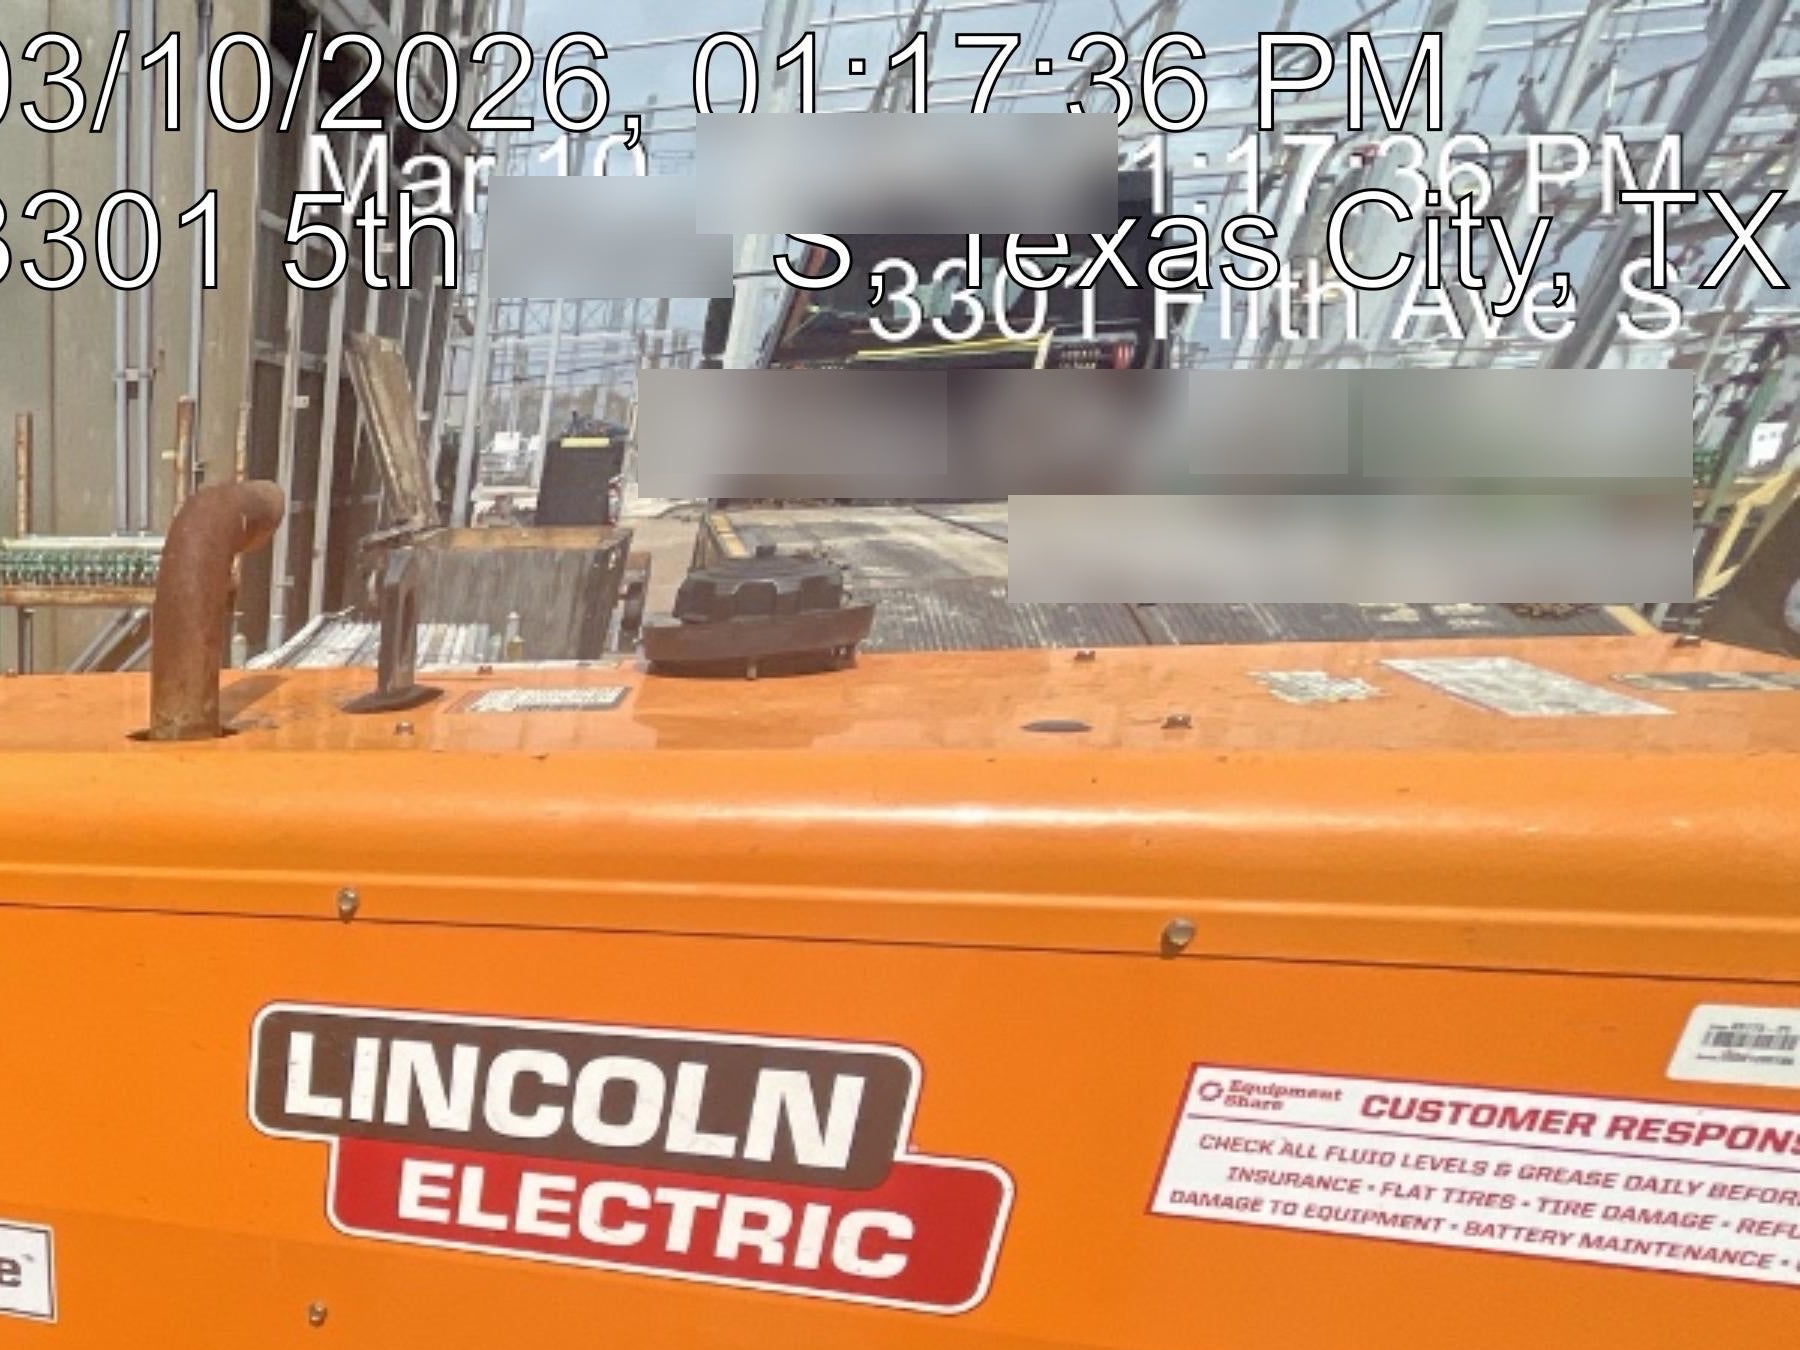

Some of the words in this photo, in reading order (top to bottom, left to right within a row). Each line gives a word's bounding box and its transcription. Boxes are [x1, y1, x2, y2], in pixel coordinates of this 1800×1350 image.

[284, 1031, 867, 1169] LINCOLN
[1223, 1094, 1284, 1111] Share
[1228, 1079, 1343, 1102] Equipment
[1360, 1093, 1597, 1139] CUSTOMER
[1199, 1133, 1273, 1156] CHECK
[1278, 1138, 1318, 1159] ALL
[1324, 1145, 1397, 1169] FLUID
[1401, 1152, 1490, 1177] LEVELS
[1493, 1161, 1512, 1177] &
[1517, 1163, 1620, 1190] GREASE
[1623, 1174, 1705, 1197] DAILY
[1707, 1180, 1800, 1207] BEFOR
[1227, 1166, 1363, 1194] INSURANCE
[1379, 1181, 1436, 1202] FLAT
[1443, 1187, 1516, 1210] TIRES
[1537, 1197, 1599, 1220] TIRE
[1601, 1204, 1718, 1231] DAMAGE
[398, 1157, 917, 1279] ELECTRIC
[1169, 1189, 1264, 1214] DAMAGE
[1269, 1199, 1300, 1216] TO
[1303, 1204, 1445, 1234] EQUIPMENT
[1463, 1220, 1576, 1247] BATTERY
[1577, 1232, 1777, 1271] MAINTENANCE
